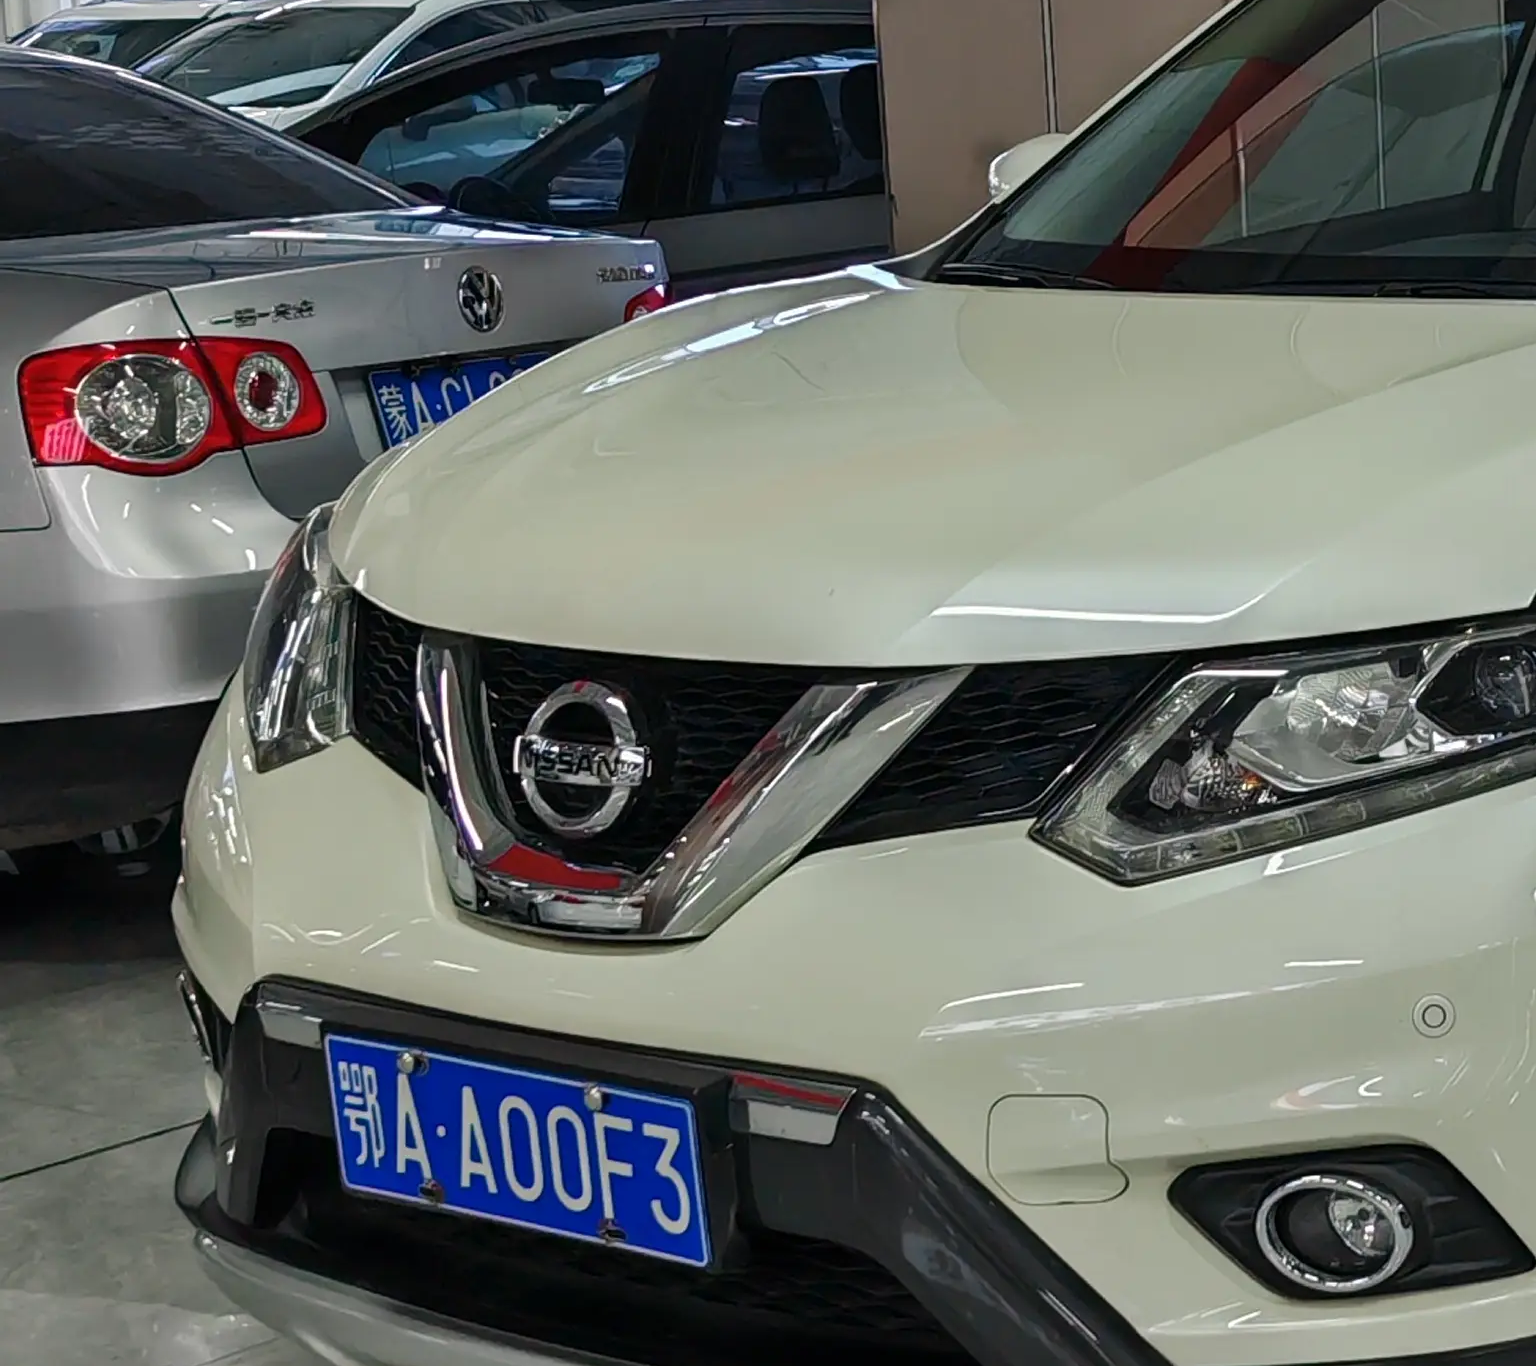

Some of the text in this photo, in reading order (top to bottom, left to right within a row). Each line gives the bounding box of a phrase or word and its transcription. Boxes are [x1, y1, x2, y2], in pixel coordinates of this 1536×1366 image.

[378, 368, 524, 443] 蒙A·C
[522, 739, 621, 779] NISSAN
[337, 1061, 691, 1235] 鄂A·A00F3
